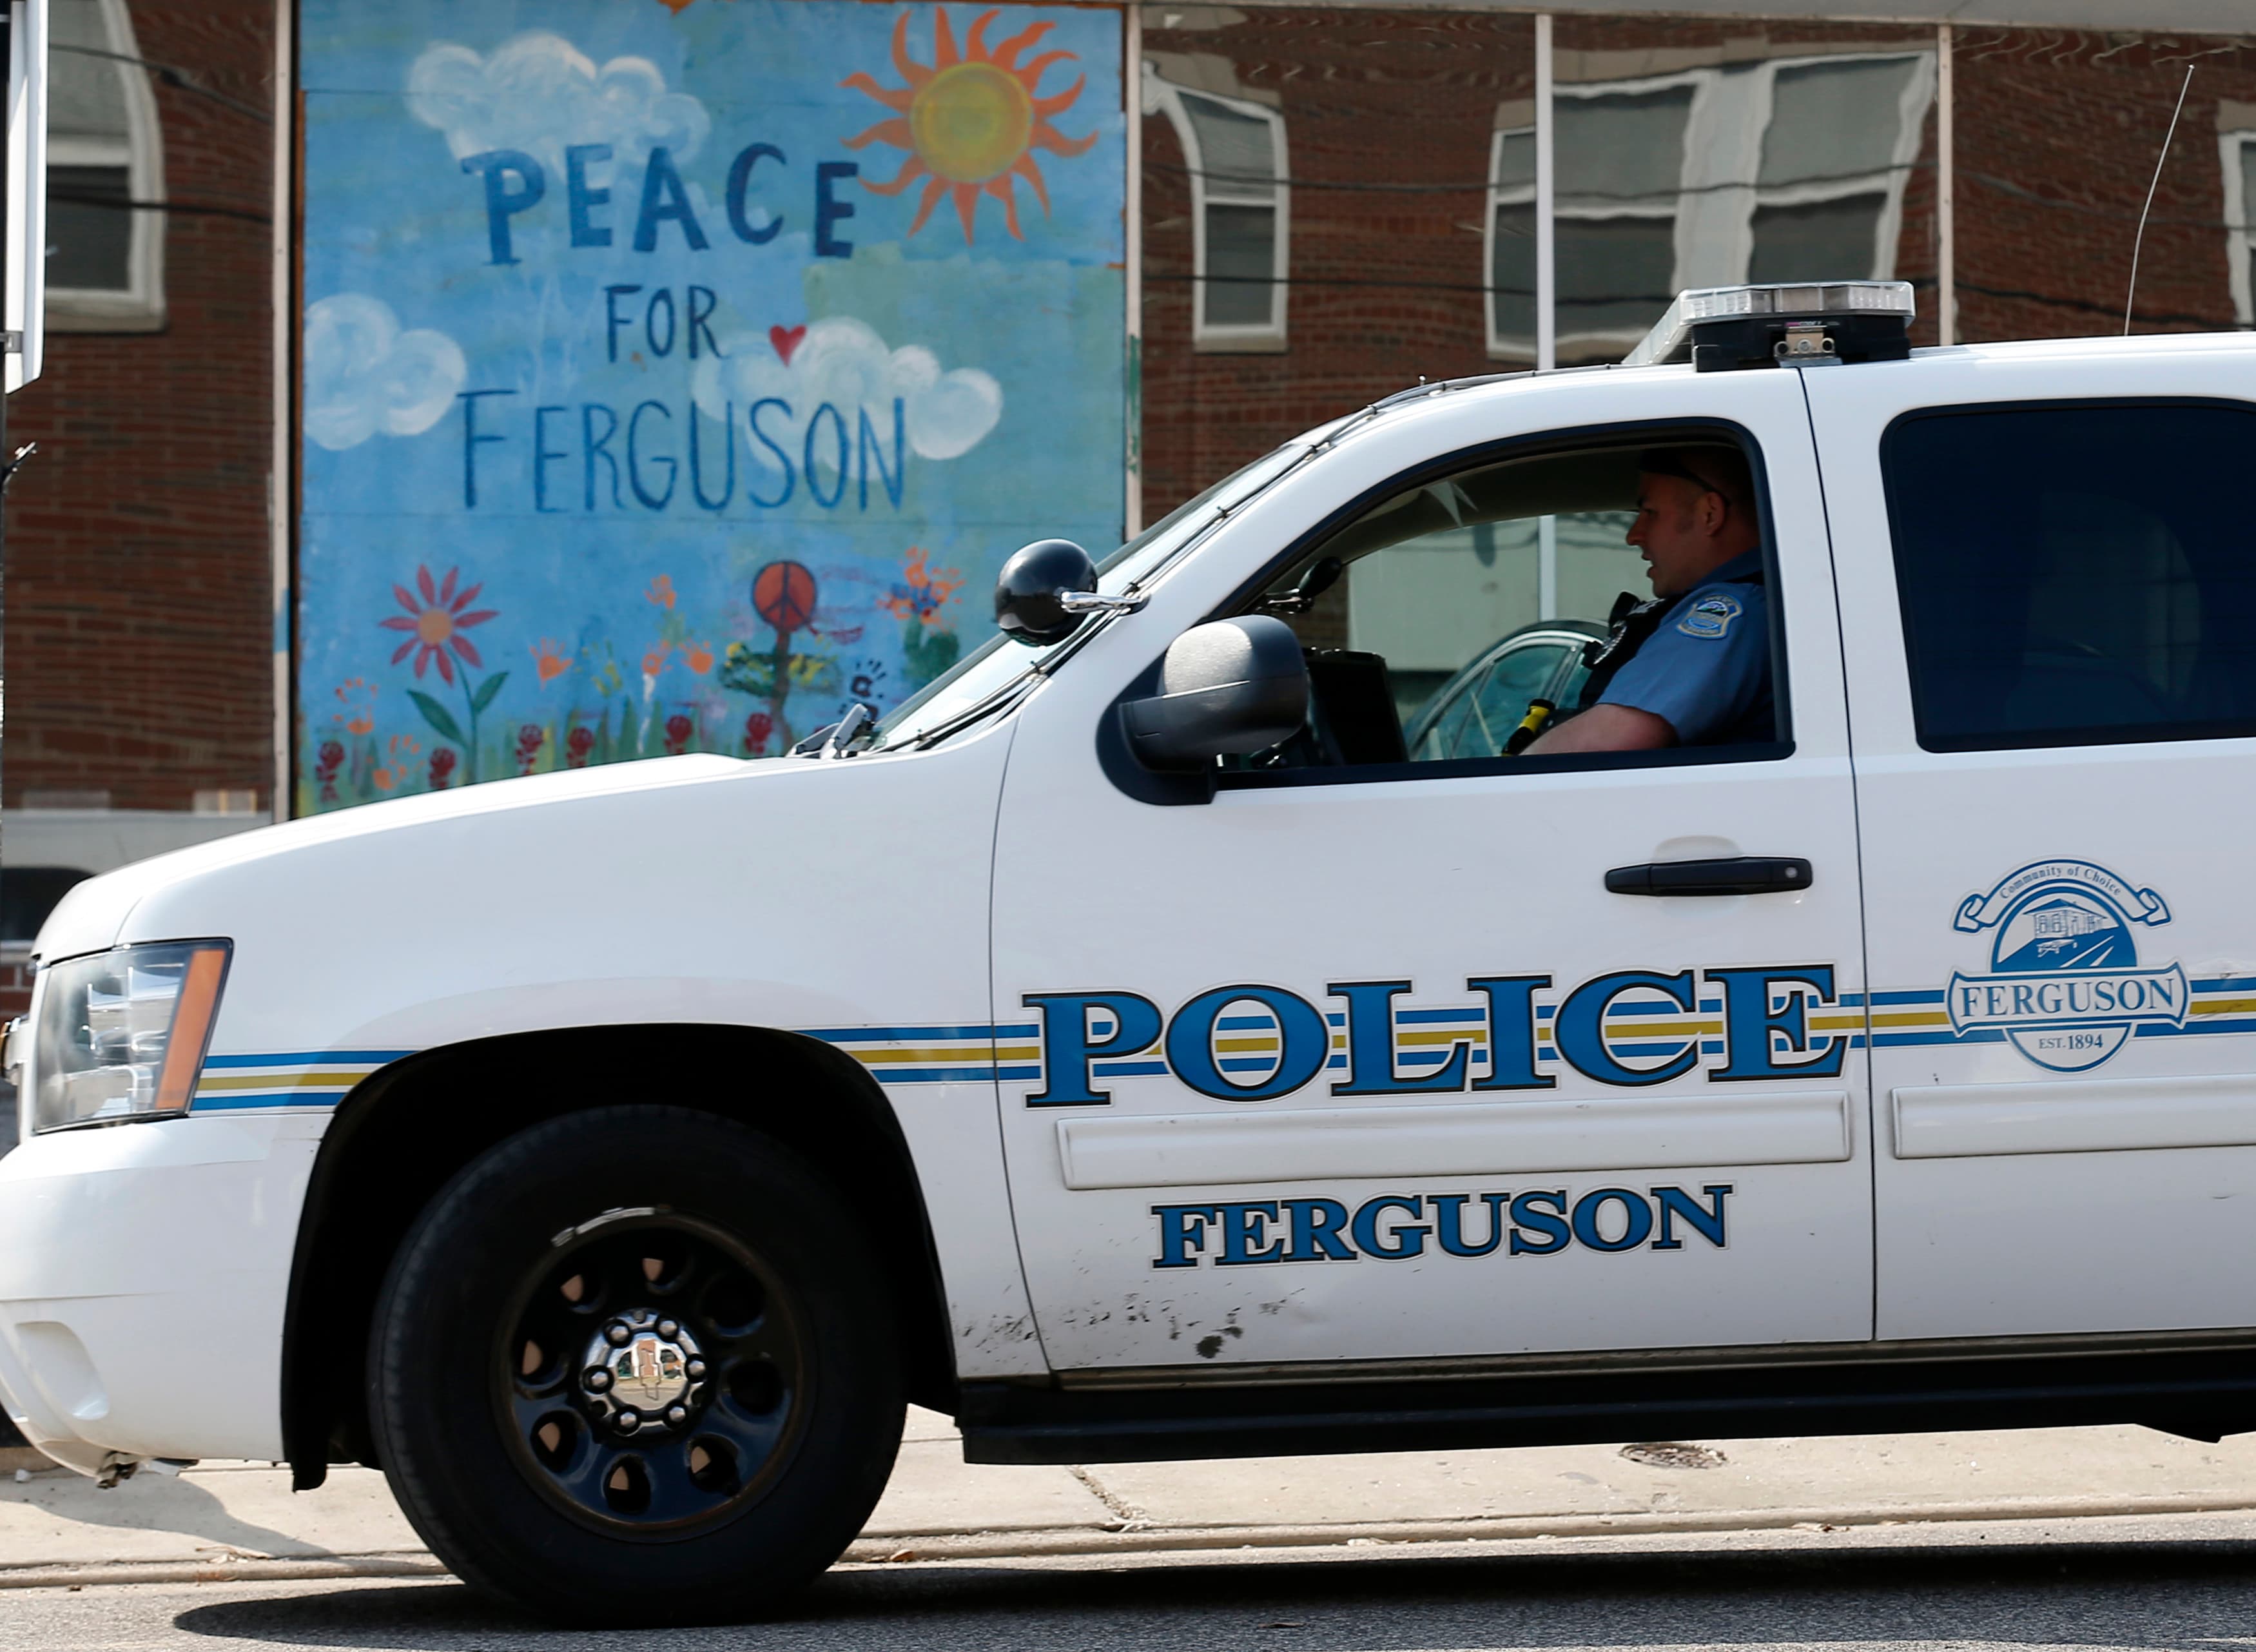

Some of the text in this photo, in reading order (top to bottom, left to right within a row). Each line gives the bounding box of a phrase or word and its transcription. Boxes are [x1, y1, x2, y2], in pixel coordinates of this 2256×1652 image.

[460, 142, 859, 266] PEACE
[604, 284, 730, 364] FOR
[456, 389, 906, 514] FERGUSON
[1999, 866, 2121, 899] Community of Choice
[1021, 963, 1849, 1108] POLICE
[1960, 978, 2175, 1016] FERGUSON
[2068, 1034, 2103, 1049] 1894
[1151, 1184, 1734, 1270] FERGUSON
